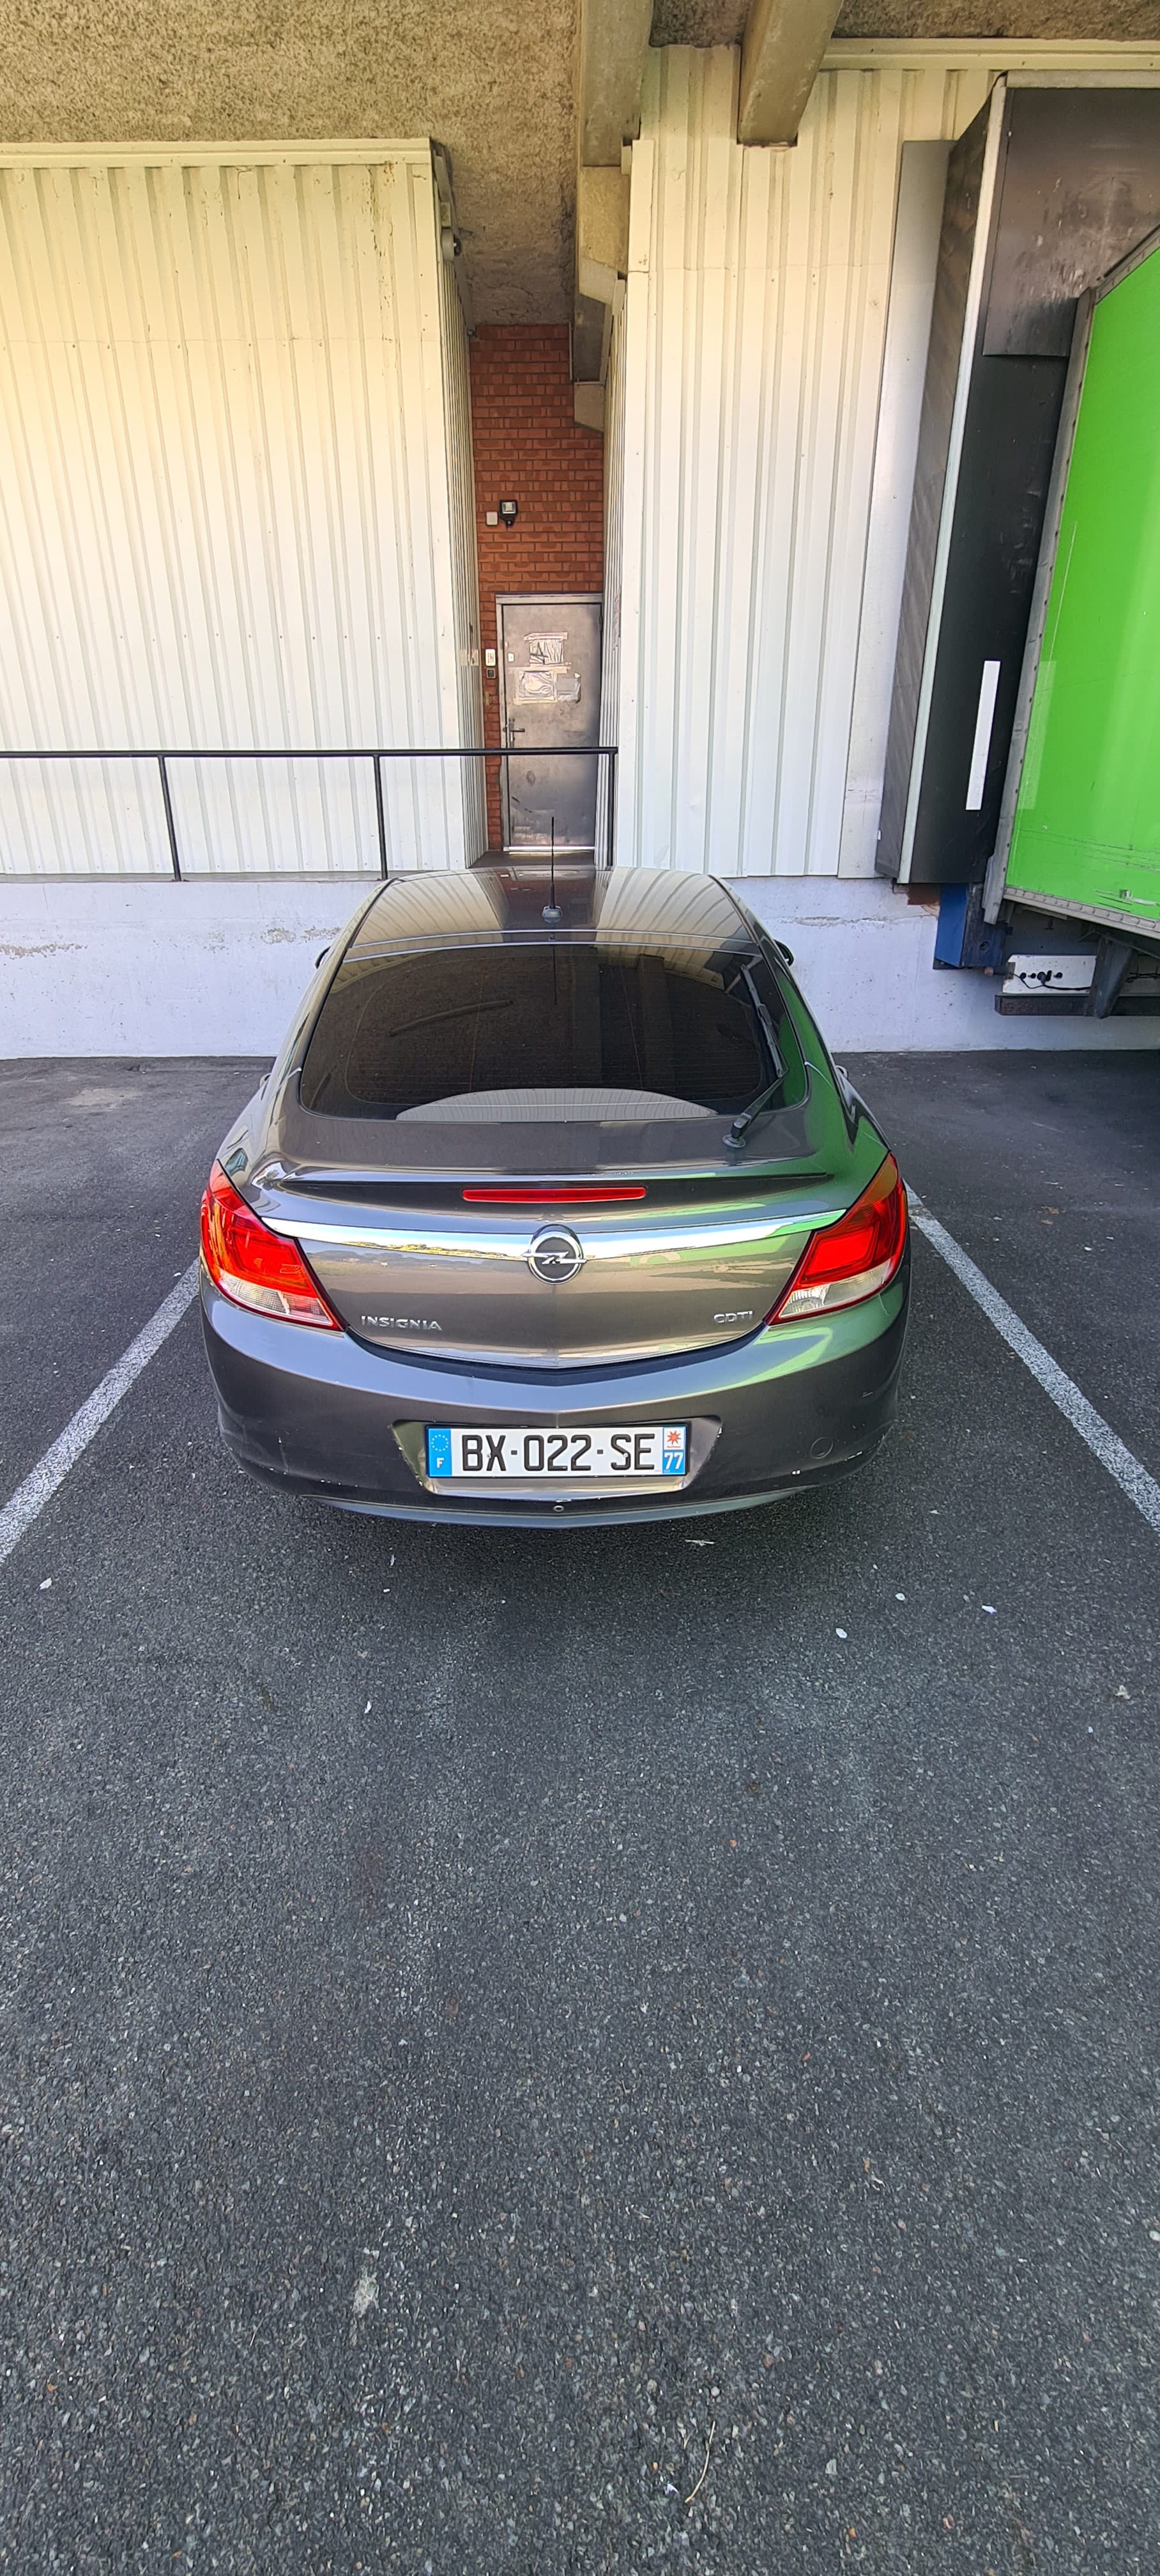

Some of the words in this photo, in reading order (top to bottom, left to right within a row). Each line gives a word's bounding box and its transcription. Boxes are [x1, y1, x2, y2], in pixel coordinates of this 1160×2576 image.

[361, 1315, 442, 1331] INSIGNIA
[714, 1310, 753, 1324] CDTI
[461, 1433, 655, 1471] BX-022-SE
[436, 1457, 445, 1469] F
[664, 1451, 684, 1470] 77
